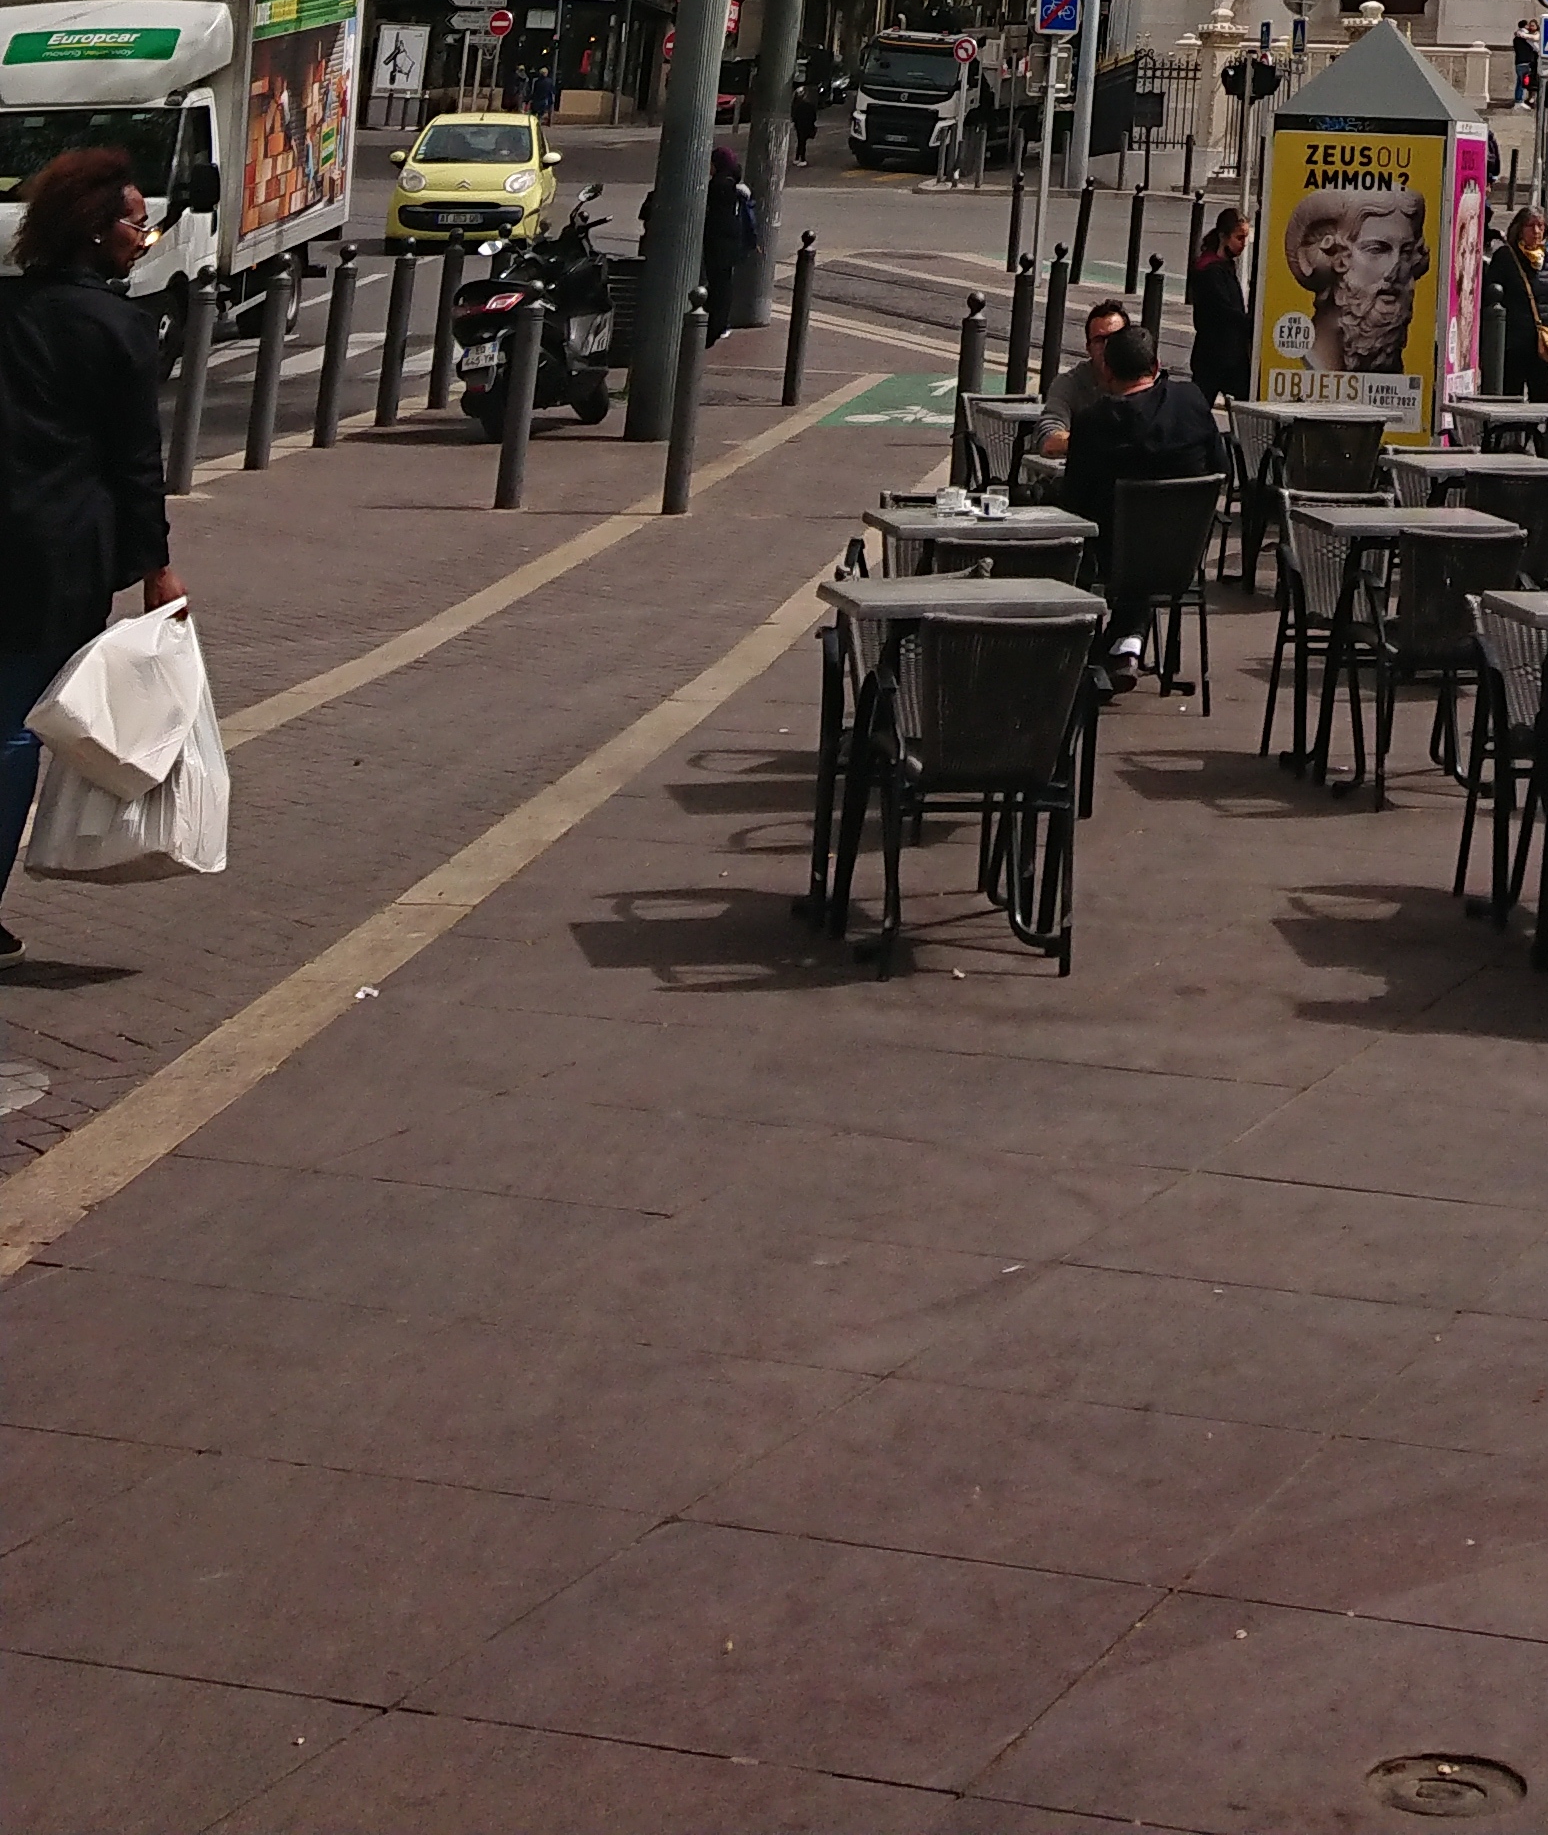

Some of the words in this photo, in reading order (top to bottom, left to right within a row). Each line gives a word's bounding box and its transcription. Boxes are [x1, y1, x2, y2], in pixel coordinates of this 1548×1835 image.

[47, 32, 140, 47] Europcar
[1305, 144, 1373, 167] ZEUS
[1303, 168, 1392, 192] AMMON
[1279, 325, 1310, 340] EXPO
[1274, 372, 1359, 401] OBJETS
[1375, 384, 1399, 395] AVRIL
[1379, 395, 1395, 406] OCT
[1397, 397, 1416, 407] 2022
